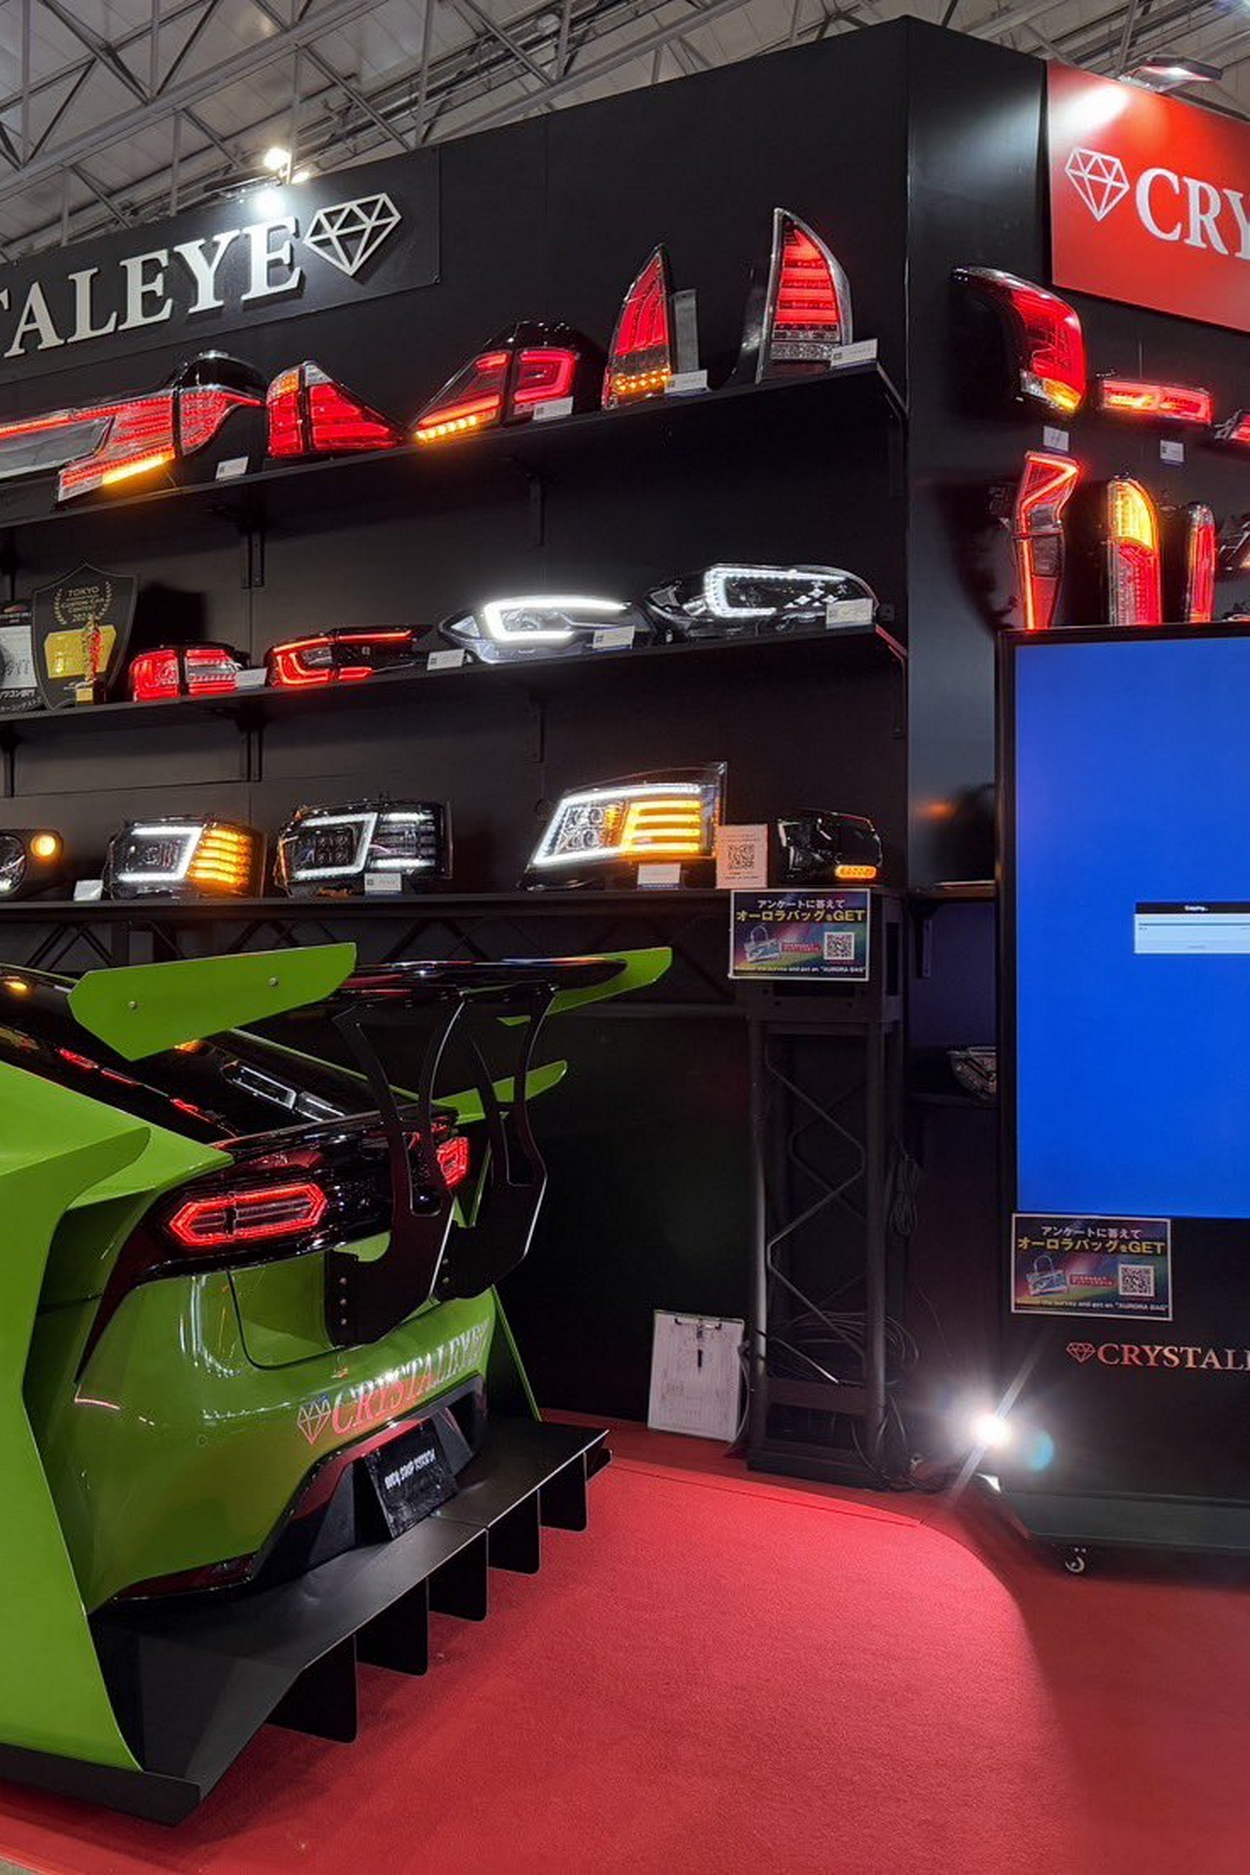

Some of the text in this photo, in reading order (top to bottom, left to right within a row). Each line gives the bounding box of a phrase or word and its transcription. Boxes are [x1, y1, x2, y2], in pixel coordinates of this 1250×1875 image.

[1135, 167, 1250, 260] CRY
[1041, 1226, 1143, 1240] アンケートに答えて
